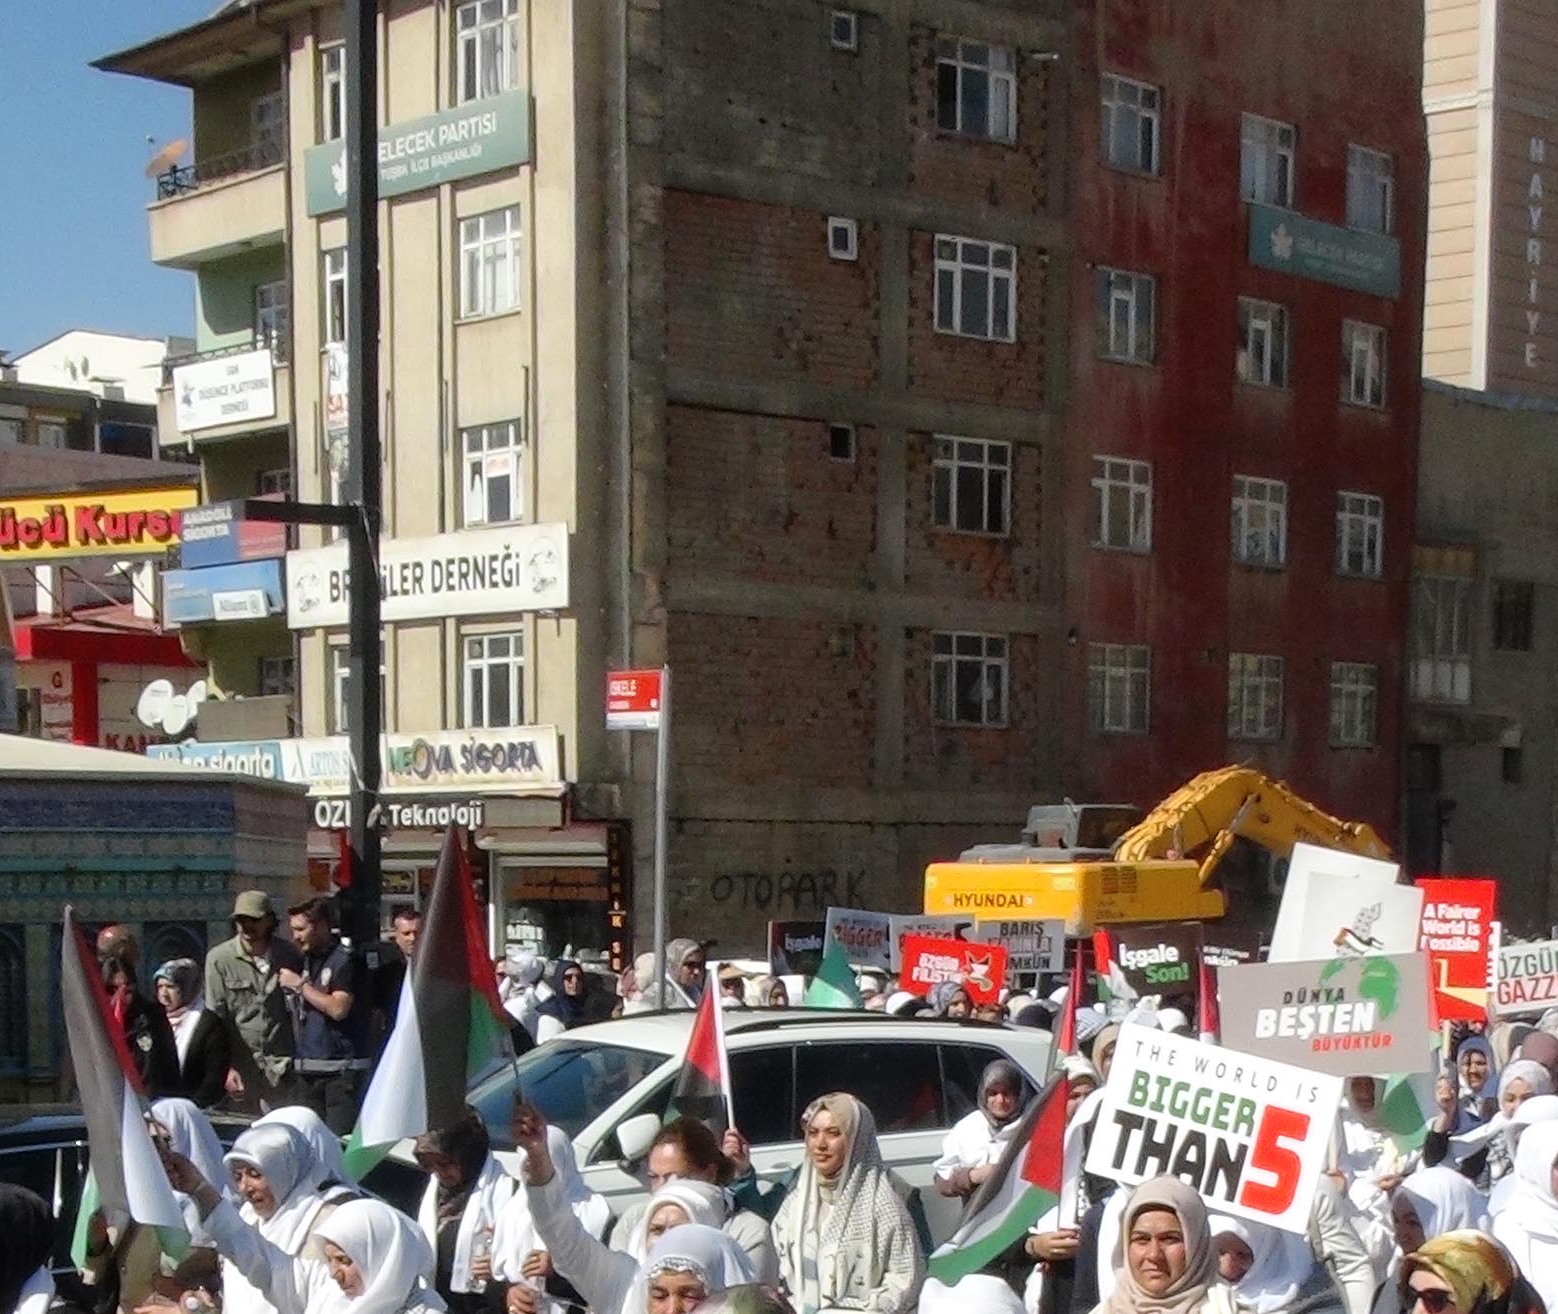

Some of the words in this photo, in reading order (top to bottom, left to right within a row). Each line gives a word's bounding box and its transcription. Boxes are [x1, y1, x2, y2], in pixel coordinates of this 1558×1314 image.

[377, 131, 436, 163] ELECEK
[430, 544, 521, 594] DERNEĞİ
[460, 736, 543, 775] SİGORTA
[388, 800, 485, 831] Teknoloji
[710, 868, 867, 910] OTOPARK
[952, 892, 1026, 908] HYUNDAI
[1423, 903, 1436, 919] A
[1437, 903, 1482, 920] Fairer
[1000, 921, 1045, 944] BARIŞ
[1420, 934, 1480, 952] Possible
[1422, 919, 1467, 935] World
[1468, 921, 1481, 936] is
[1145, 962, 1189, 984] Son!
[1283, 986, 1346, 1005] DÜNYA
[1254, 1001, 1376, 1041] BEŞTEN
[1311, 1033, 1393, 1053] BÜYÜKTÜR
[1134, 1039, 1178, 1066] THE
[1194, 1055, 1278, 1092] WORLD
[1295, 1082, 1320, 1104] IS
[1126, 1069, 1258, 1138] BIGGER
[1111, 1108, 1249, 1203] THAN
[1238, 1103, 1312, 1216] 5
